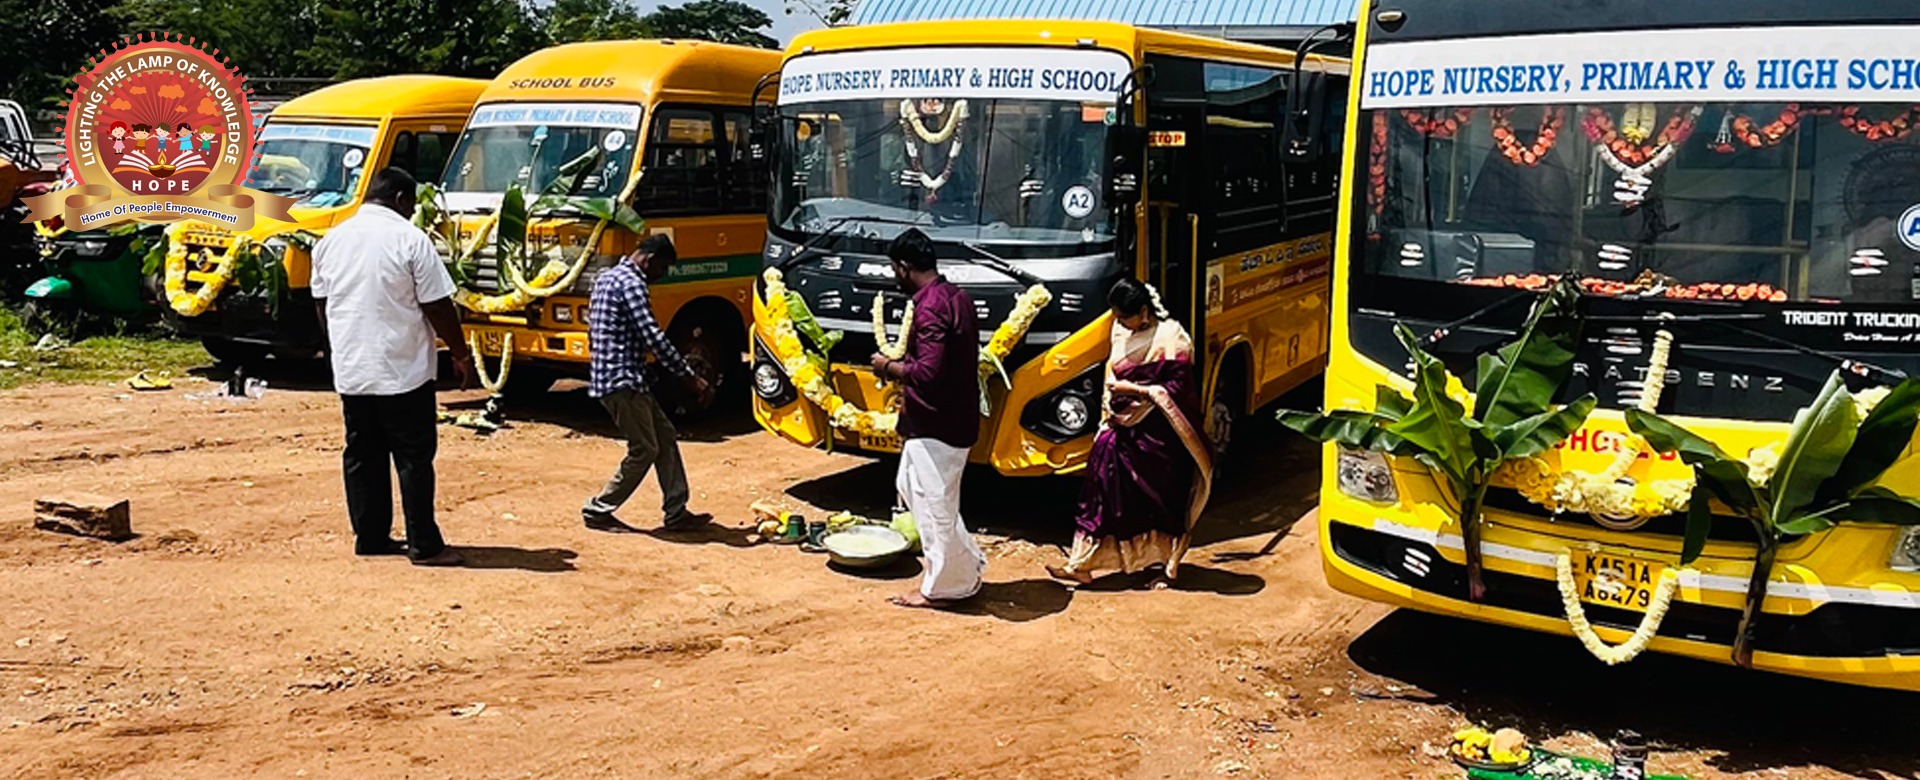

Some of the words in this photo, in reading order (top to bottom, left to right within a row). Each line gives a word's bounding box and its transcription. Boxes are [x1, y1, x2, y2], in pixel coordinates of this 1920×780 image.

[509, 78, 573, 89] SCHOOL
[579, 77, 616, 89] BUS
[782, 74, 813, 95] HOPE
[815, 69, 884, 91] NURSERY,
[890, 68, 966, 88] PRIMARY
[969, 68, 983, 88] &
[987, 68, 1034, 88] HIGH
[1040, 69, 1121, 92] SCHOOL
[1369, 69, 1435, 97] HOPE
[1442, 64, 1571, 93] NURSERY,
[1581, 60, 1715, 91] PRIMARY
[1724, 59, 1746, 90] &
[1756, 58, 1840, 89] HIGH
[1847, 58, 1920, 90] SCH
[1068, 193, 1089, 208] A2
[1782, 311, 1848, 326] TRIDENT
[1585, 555, 1651, 584] KA51A
